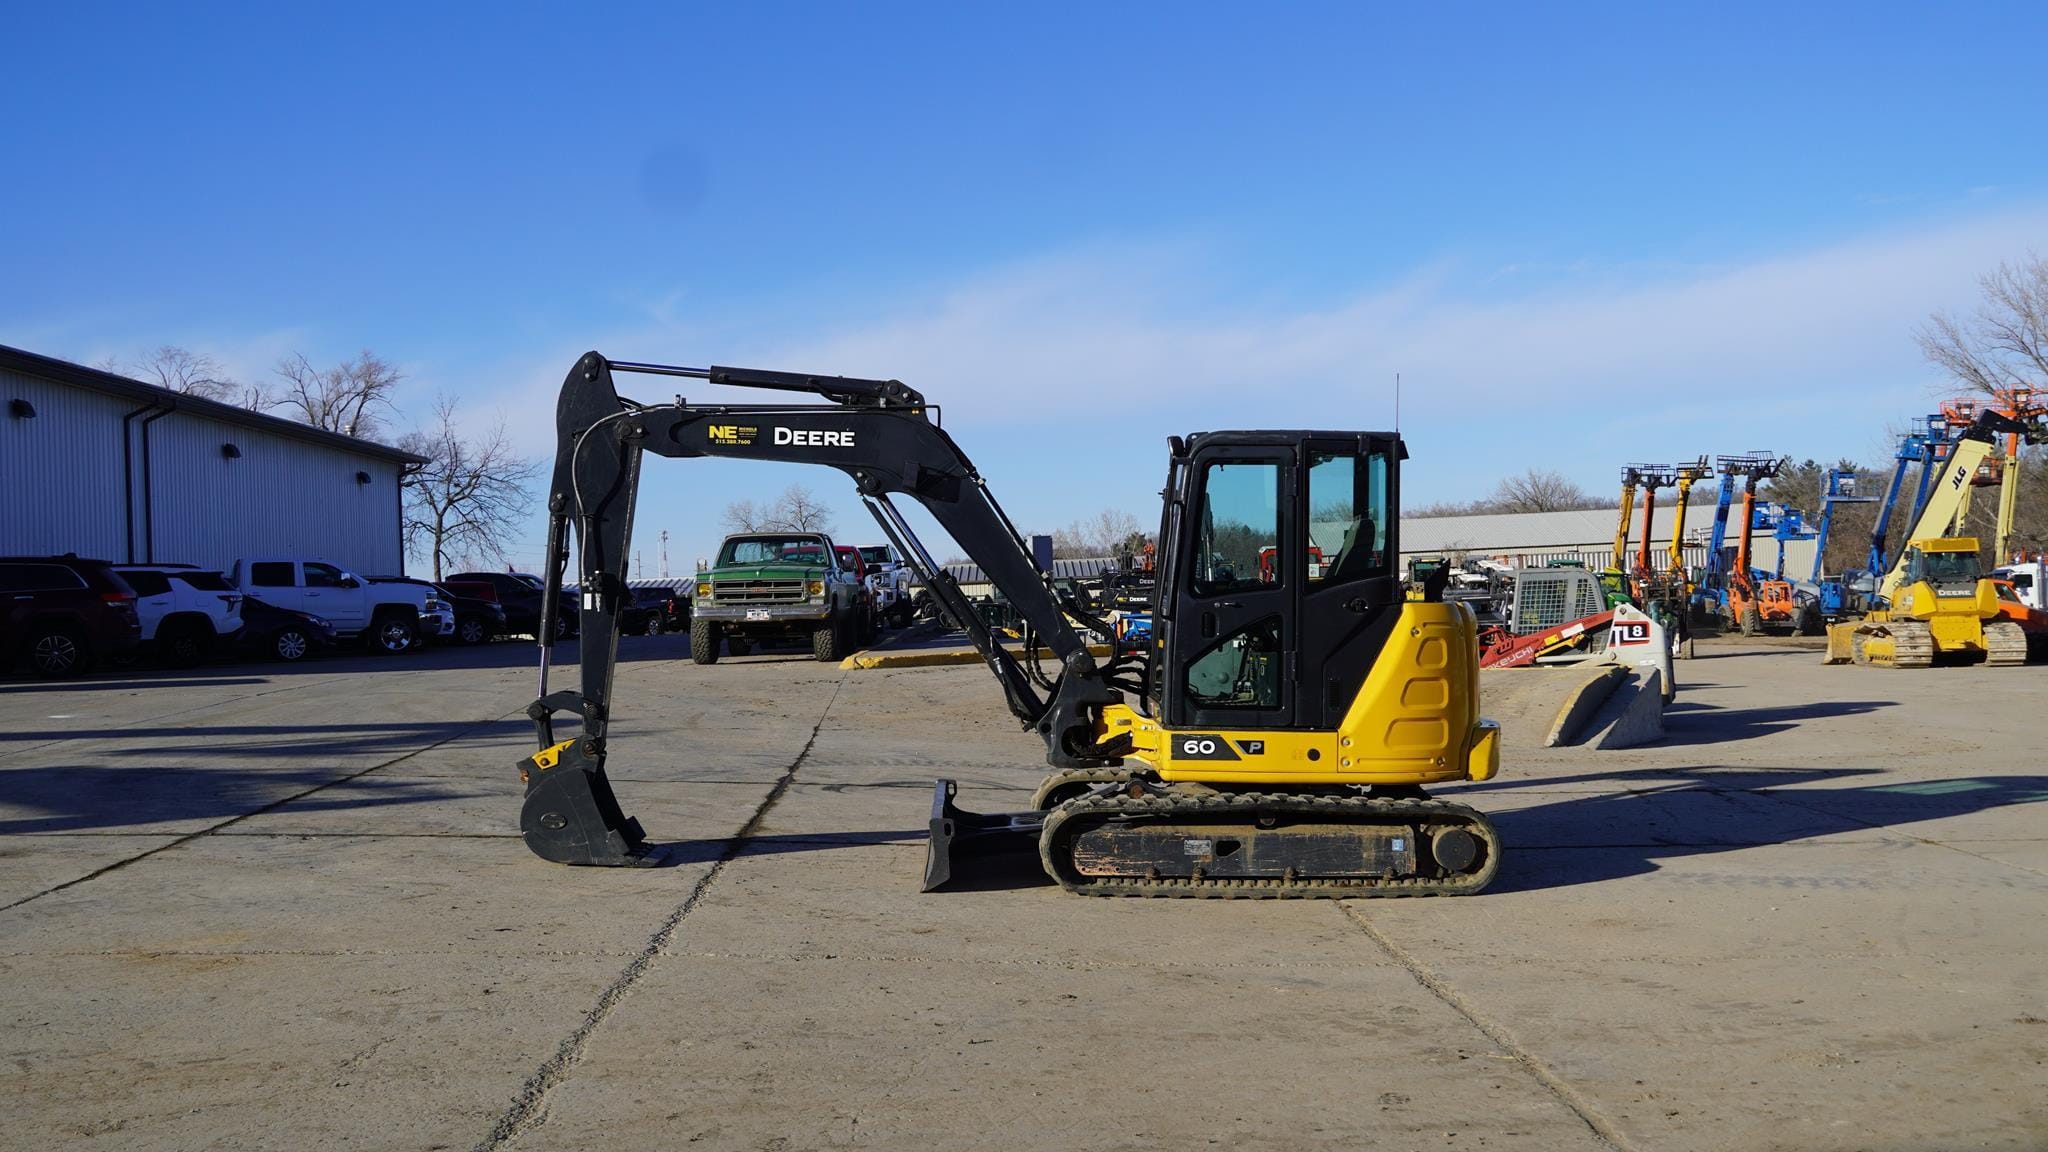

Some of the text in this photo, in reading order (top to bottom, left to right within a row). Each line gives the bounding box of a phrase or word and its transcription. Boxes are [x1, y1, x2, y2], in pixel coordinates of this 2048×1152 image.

[708, 425, 738, 439] NE
[774, 426, 856, 447] DEERE
[1951, 466, 1967, 490] JLG
[1937, 589, 1972, 597] DEERE
[1183, 740, 1263, 755] 60 P
